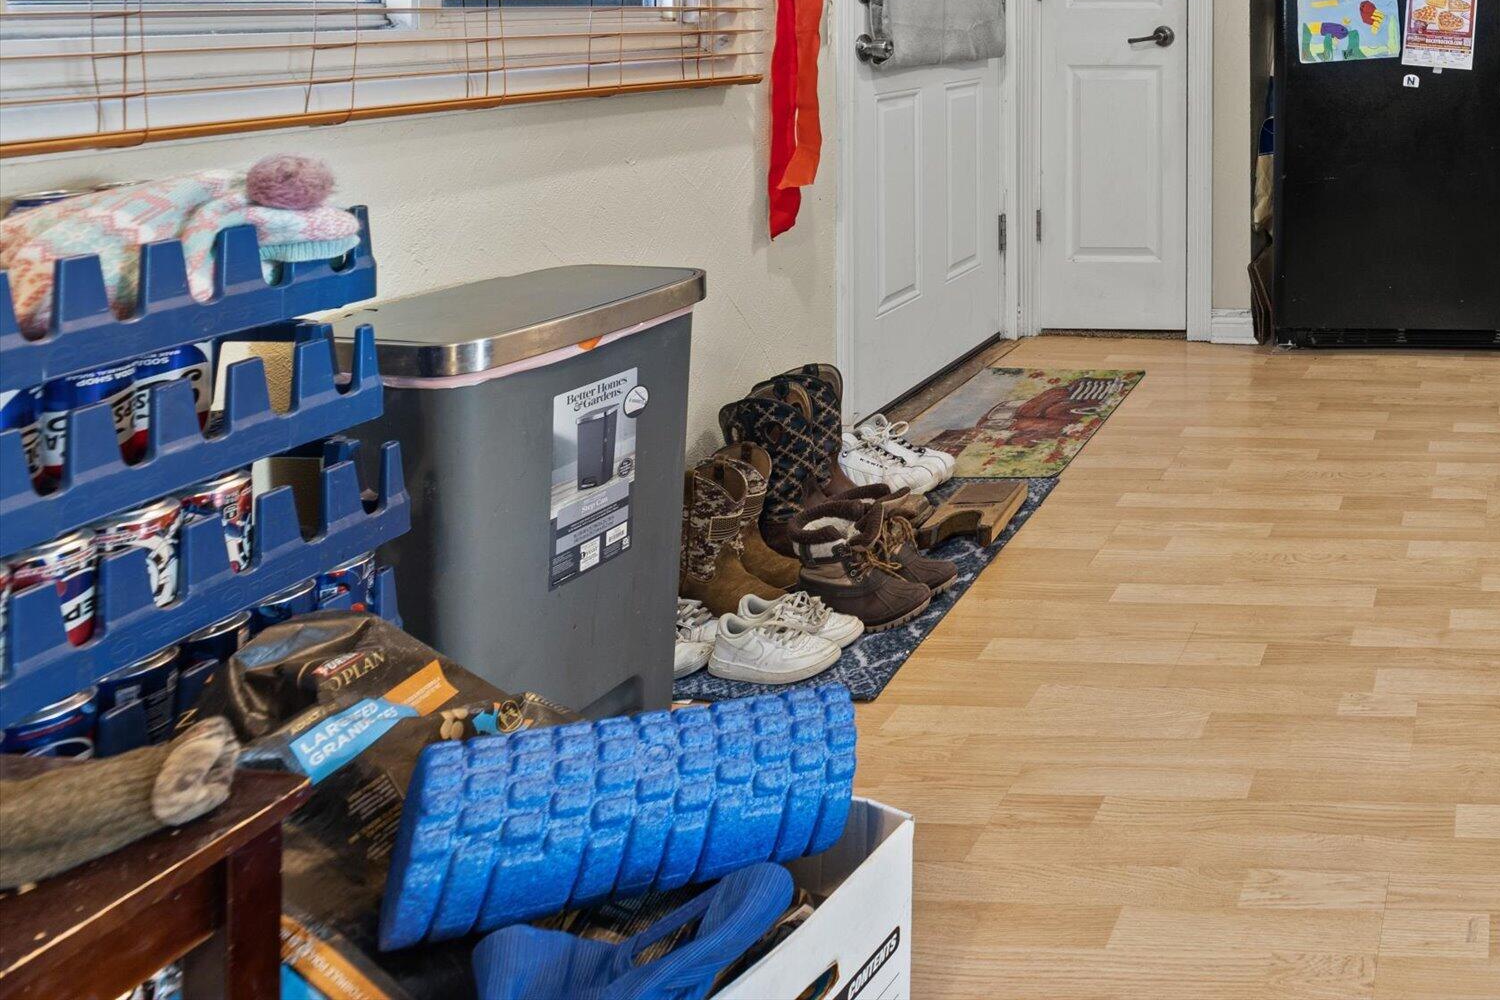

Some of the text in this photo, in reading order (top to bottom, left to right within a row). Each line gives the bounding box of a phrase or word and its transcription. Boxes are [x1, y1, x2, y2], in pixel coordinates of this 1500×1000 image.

[1406, 76, 1415, 85] N
[567, 377, 628, 405] Better Homes
[341, 650, 386, 686] PLAN
[850, 932, 898, 997] CONTENTS
